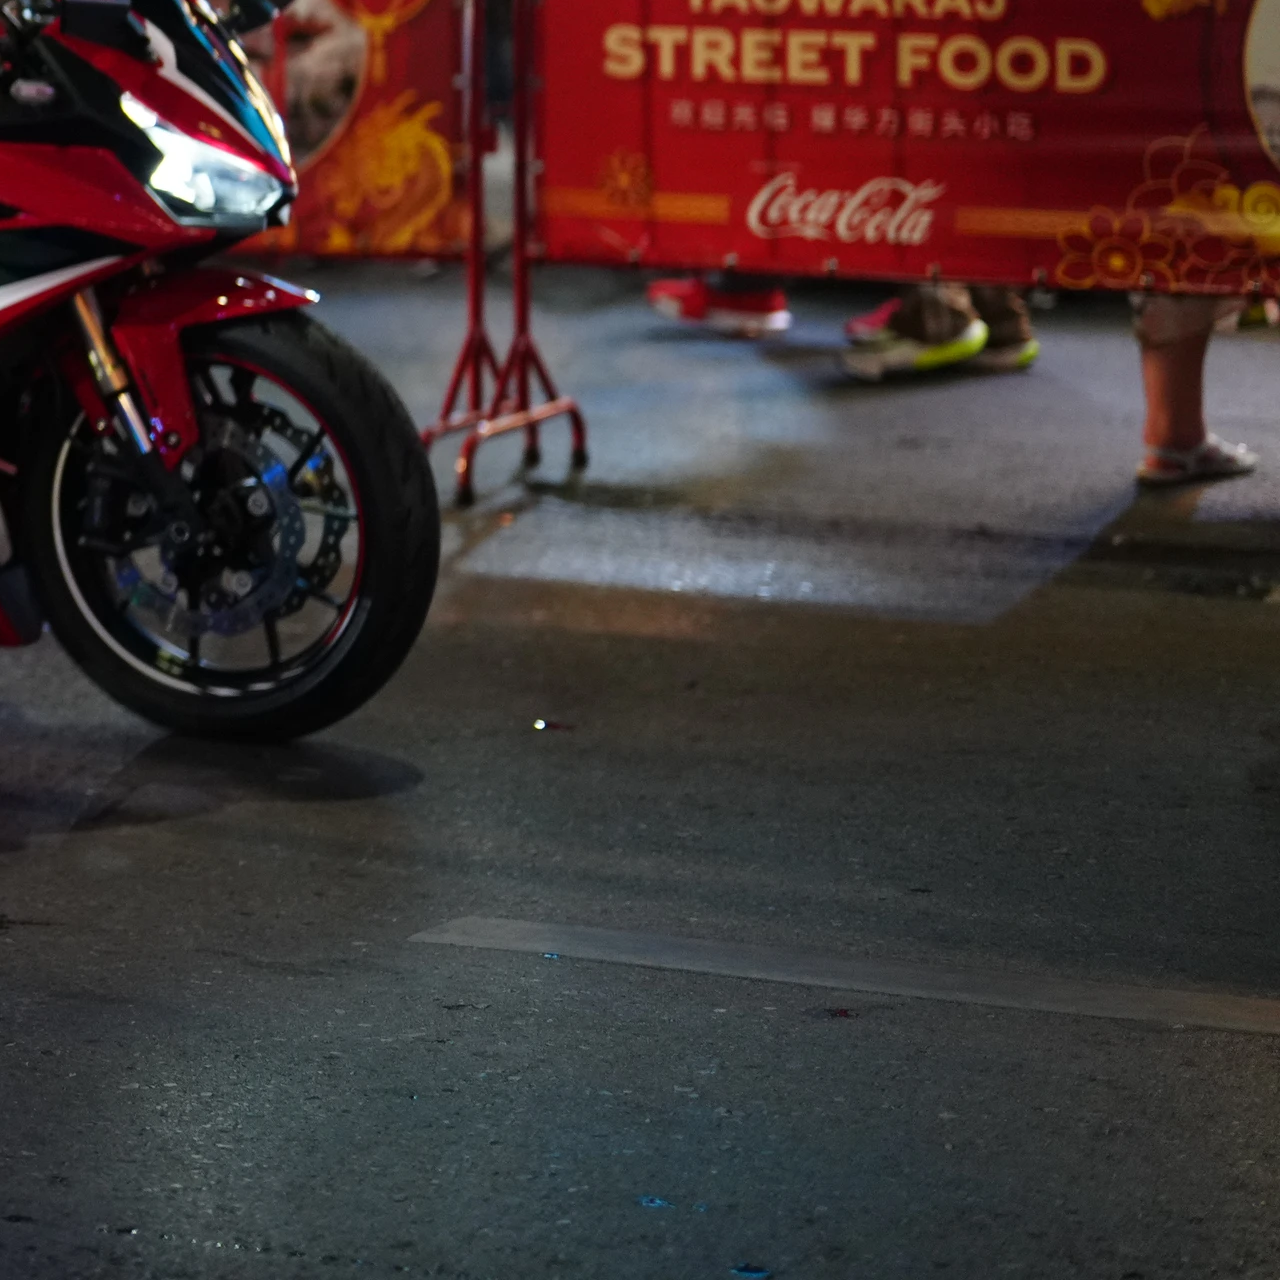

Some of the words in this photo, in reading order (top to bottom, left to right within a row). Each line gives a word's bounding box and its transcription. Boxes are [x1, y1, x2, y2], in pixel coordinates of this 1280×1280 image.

[603, 24, 877, 87] STREET
[897, 32, 1108, 94] FOOD
[746, 171, 946, 247] Coca-Cola
